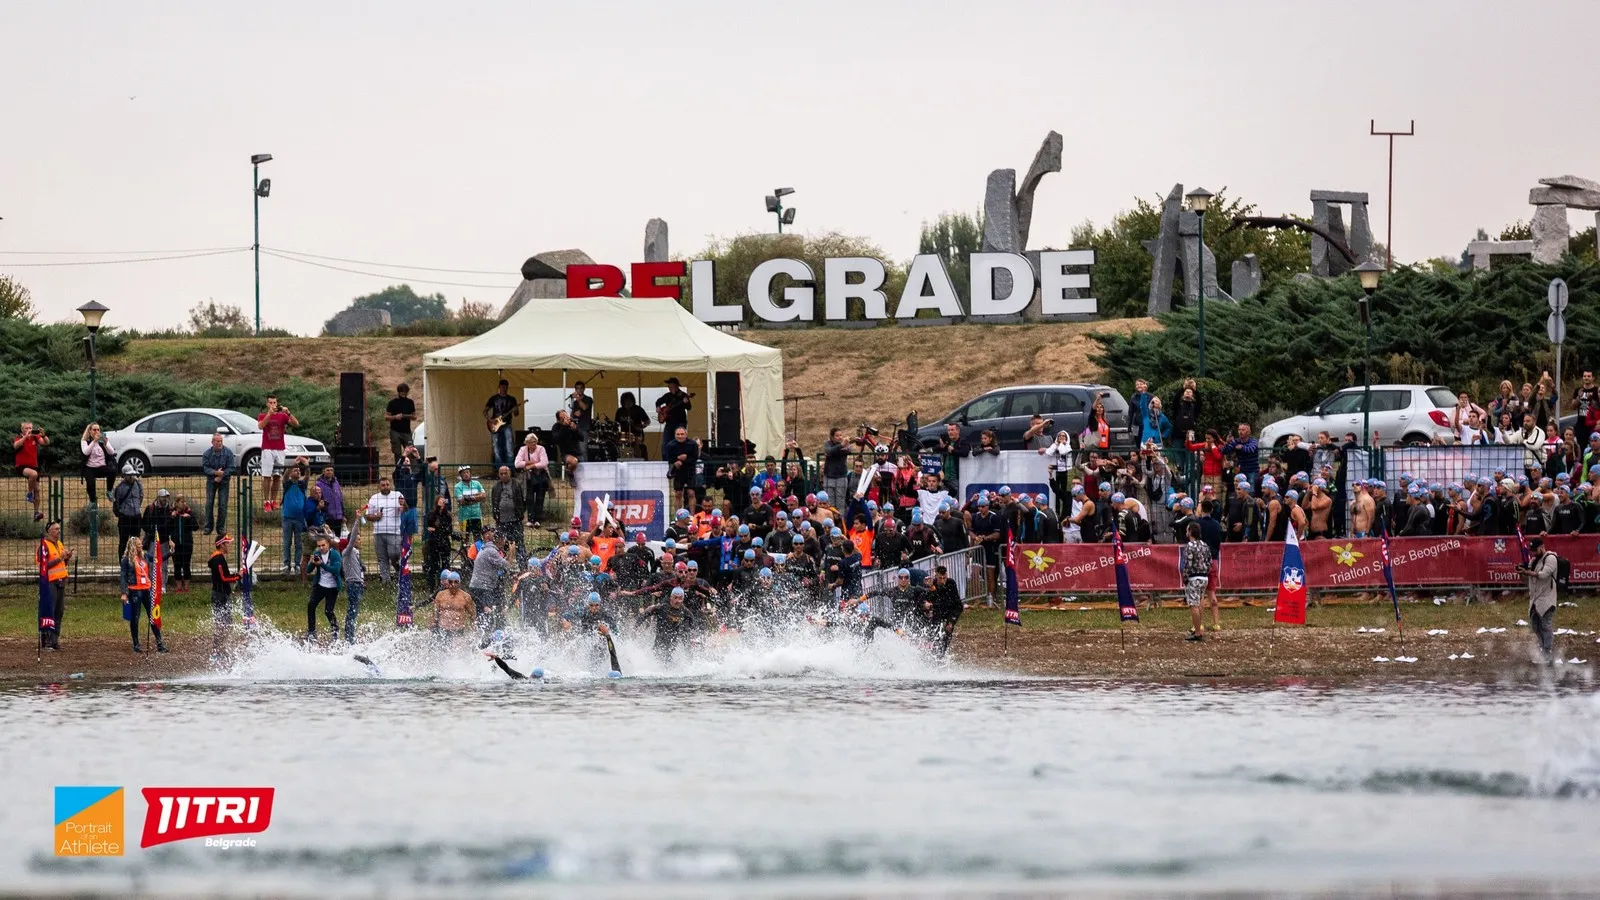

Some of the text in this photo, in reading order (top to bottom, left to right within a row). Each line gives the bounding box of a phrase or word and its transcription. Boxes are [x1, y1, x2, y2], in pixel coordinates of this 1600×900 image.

[566, 250, 1096, 322] BELGRADE
[1022, 570, 1062, 589] Triatlon
[1064, 560, 1098, 577] Savez
[1100, 547, 1151, 567] Begrada
[1330, 565, 1371, 584] Triatlon
[1408, 539, 1461, 561] Beograda
